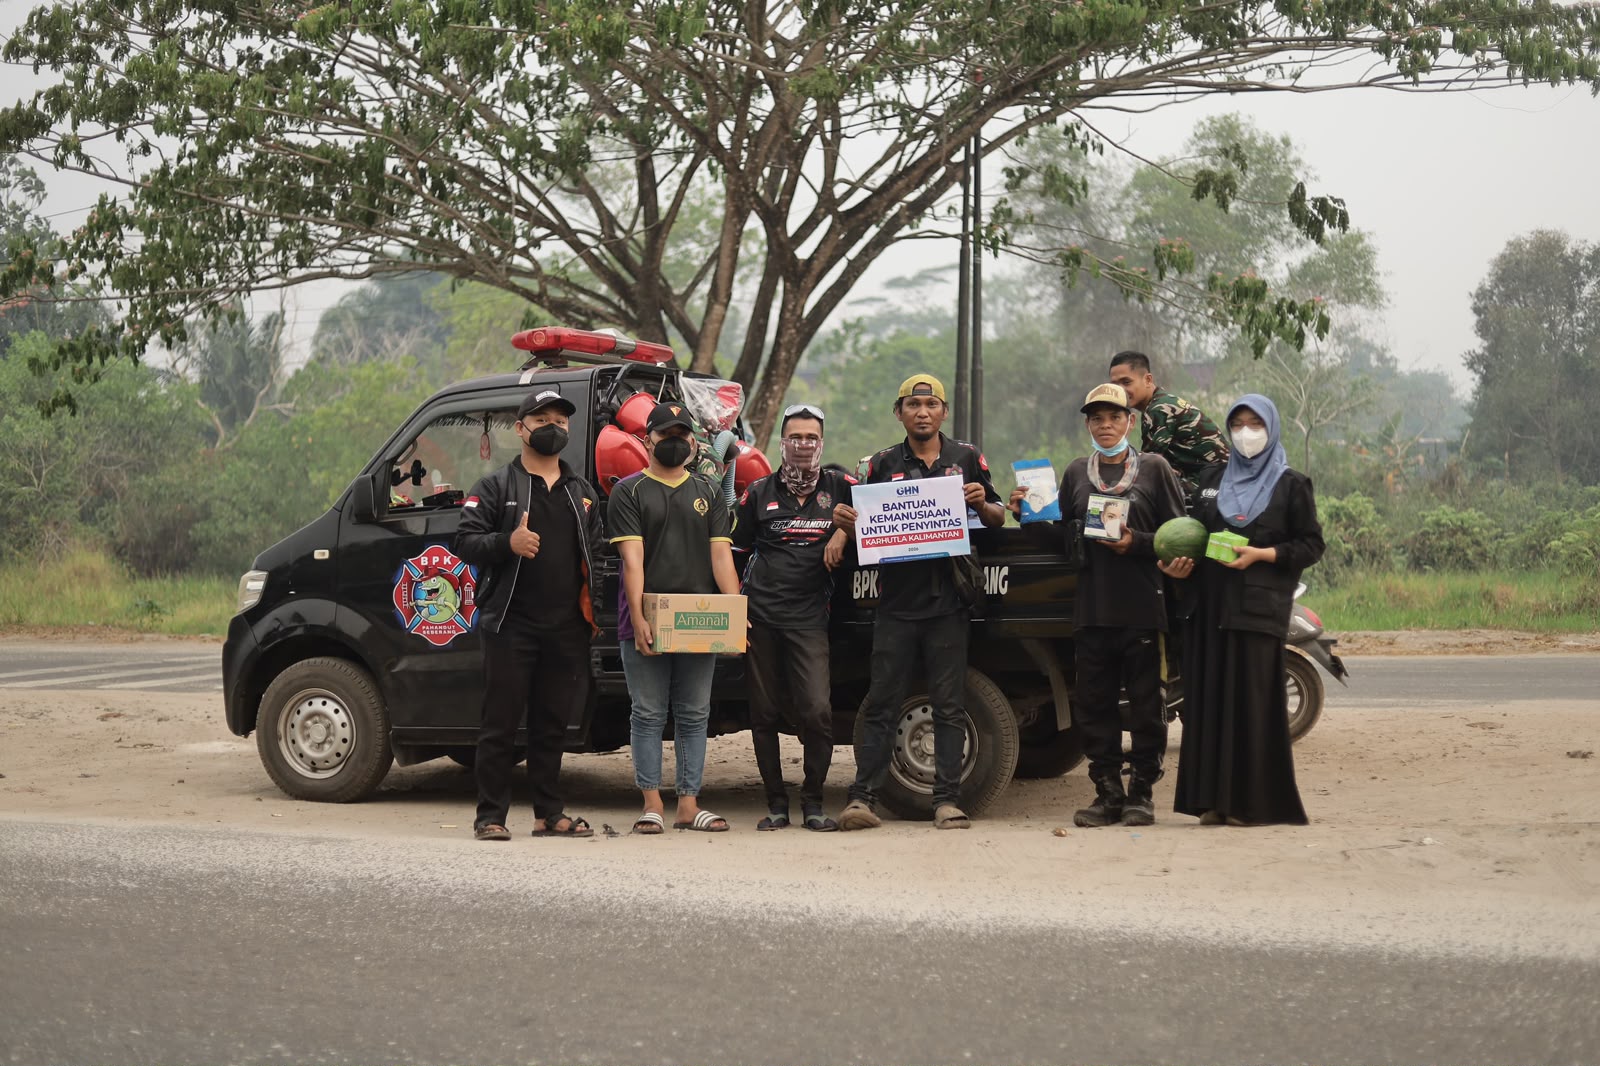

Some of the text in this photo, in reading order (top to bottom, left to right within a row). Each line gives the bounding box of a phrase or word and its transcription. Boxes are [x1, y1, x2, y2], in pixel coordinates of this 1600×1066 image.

[896, 486, 919, 496] GHN
[882, 499, 936, 512] BANTUAN
[869, 508, 951, 524] KEMANUSIAAN
[861, 518, 962, 536] UNTUK PENYINTAS
[865, 530, 960, 546] KARHUTLA KALIMANTAN
[421, 556, 452, 566] BPK
[853, 570, 879, 599] BPK
[676, 614, 728, 626] Amanah
